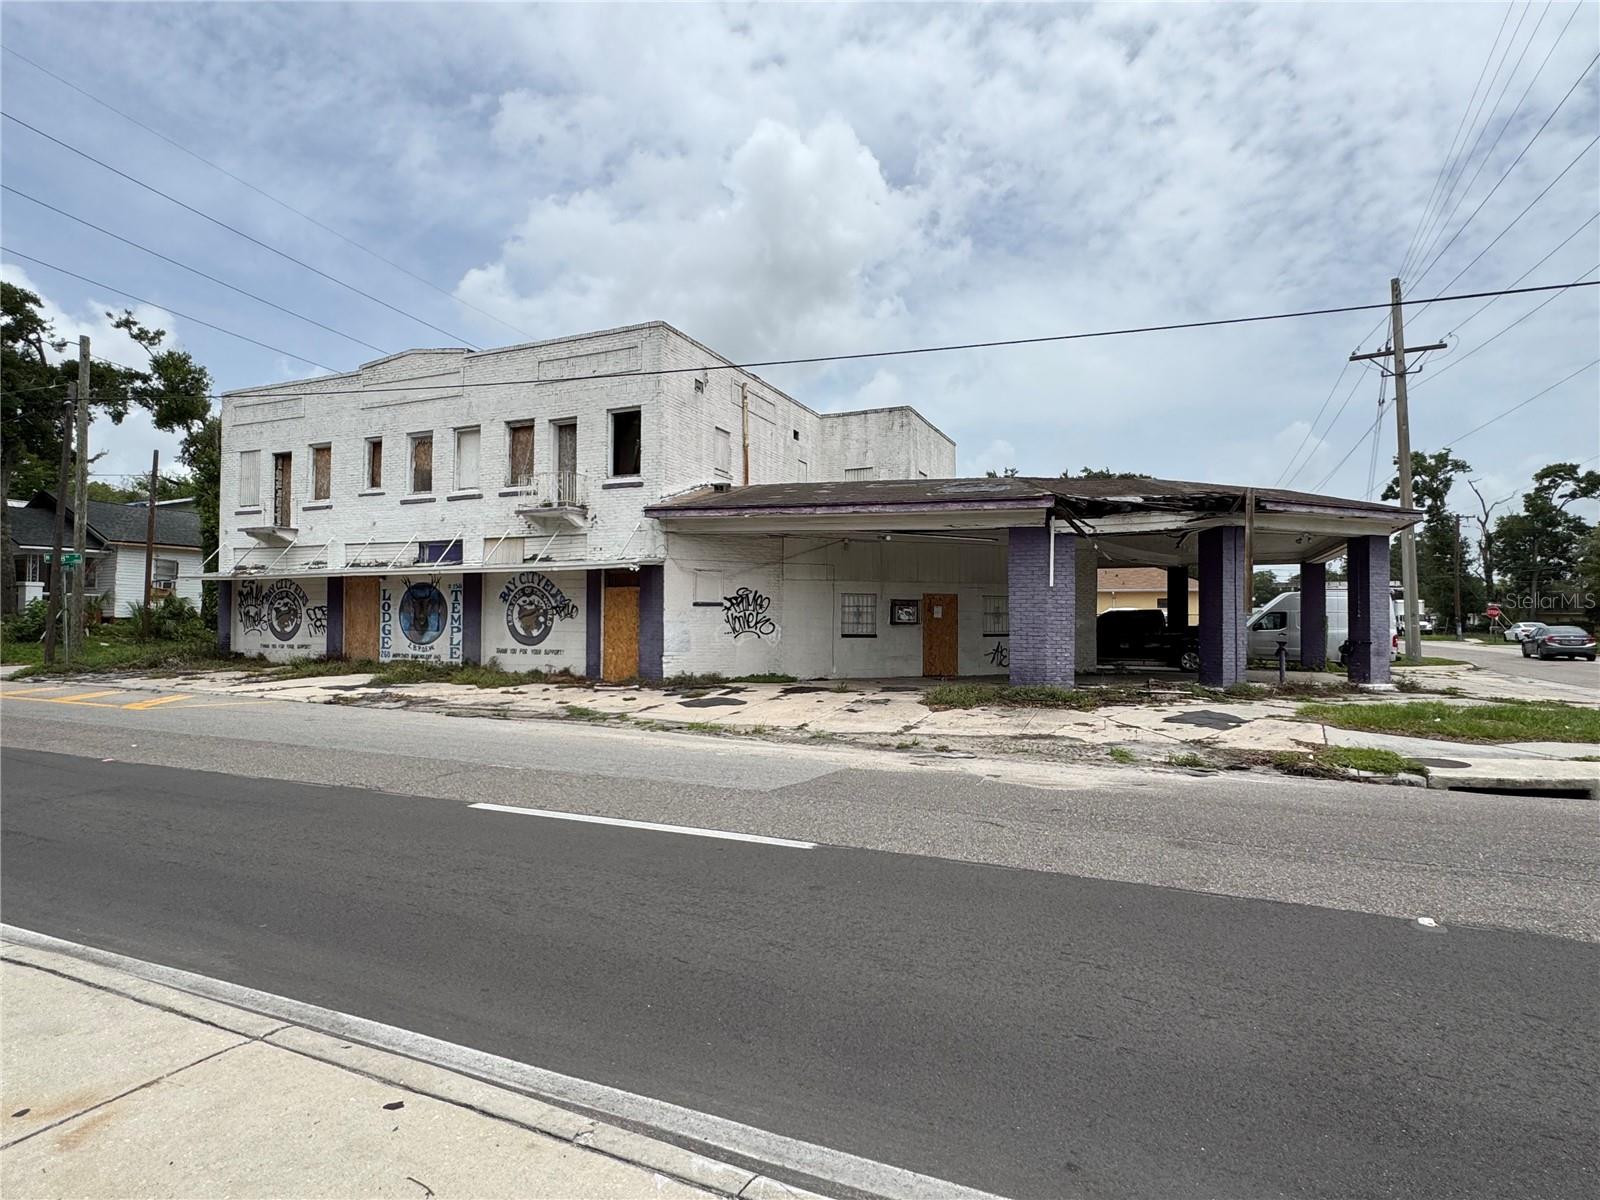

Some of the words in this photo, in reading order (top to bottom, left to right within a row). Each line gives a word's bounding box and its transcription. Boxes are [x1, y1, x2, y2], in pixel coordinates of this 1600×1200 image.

[276, 578, 295, 590] CITY
[499, 577, 518, 604] BAY
[519, 571, 546, 586] CITY
[381, 589, 392, 649] LODGE
[450, 590, 462, 659] TEMPLE
